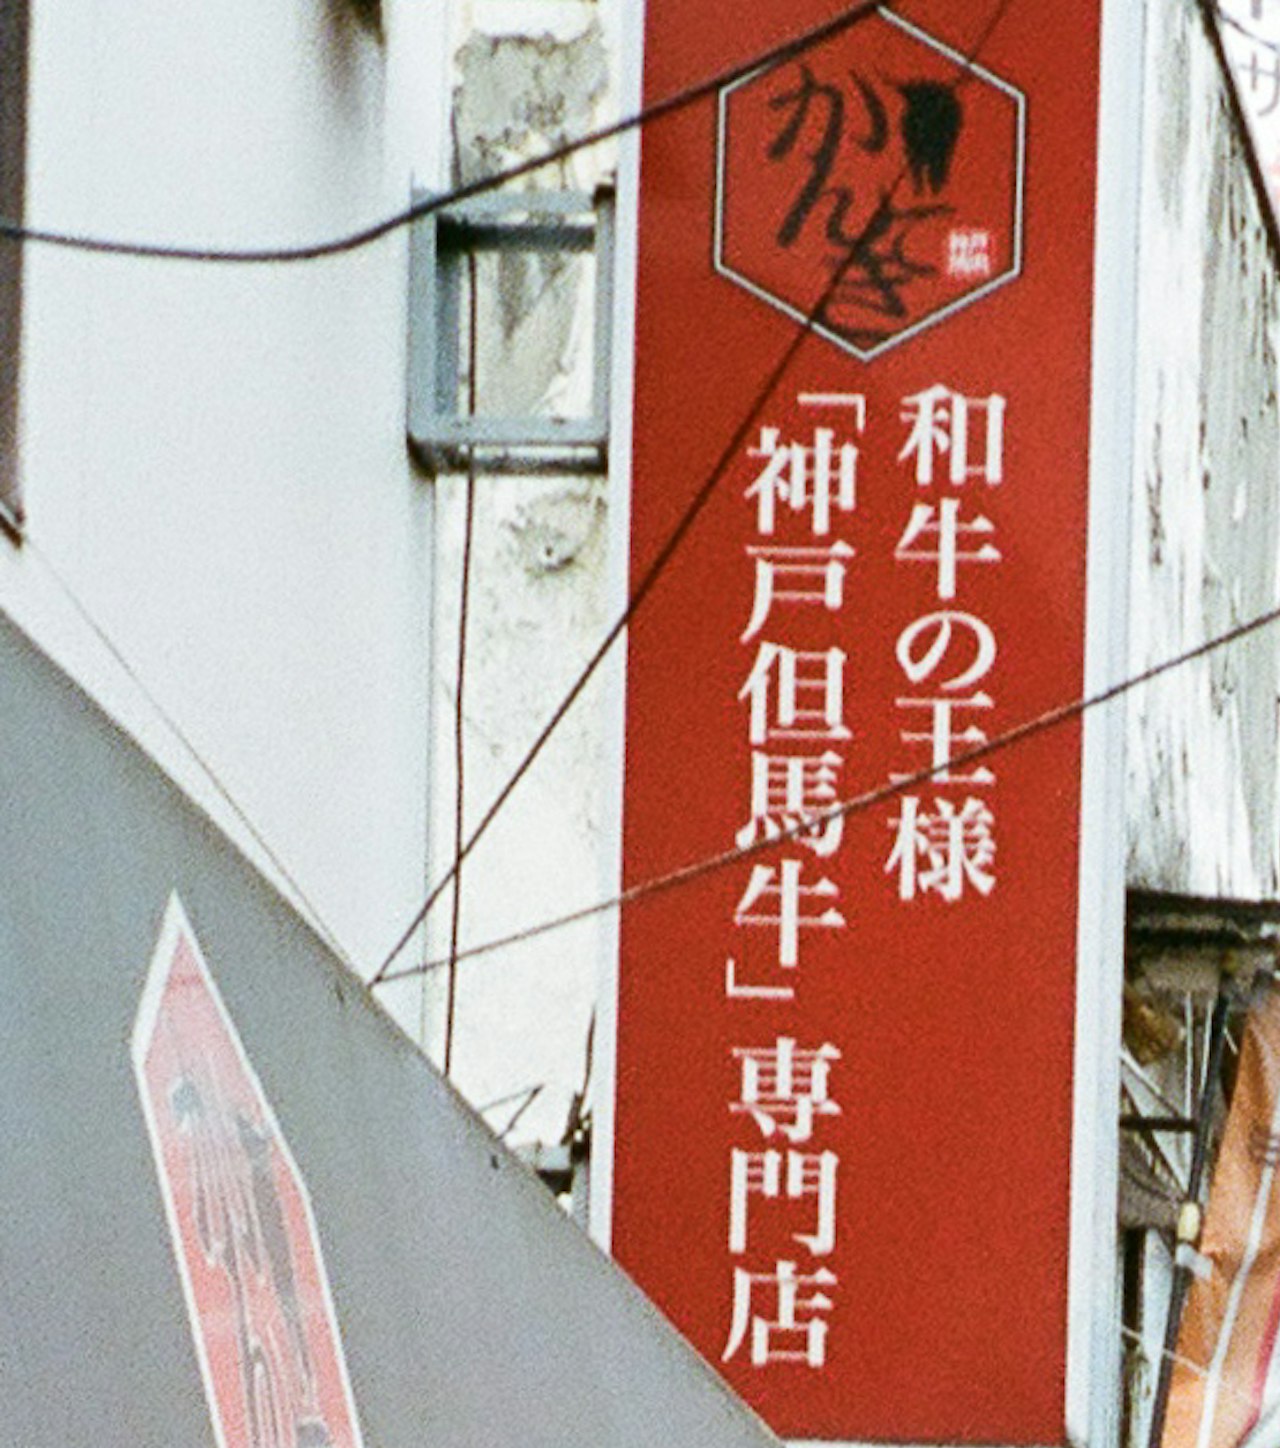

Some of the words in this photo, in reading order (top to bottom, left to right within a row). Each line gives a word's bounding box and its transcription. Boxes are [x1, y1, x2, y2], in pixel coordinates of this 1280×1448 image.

[723, 391, 863, 1369] 「神戸但馬牛」専門店
[884, 384, 1006, 902] 和牛の王様
